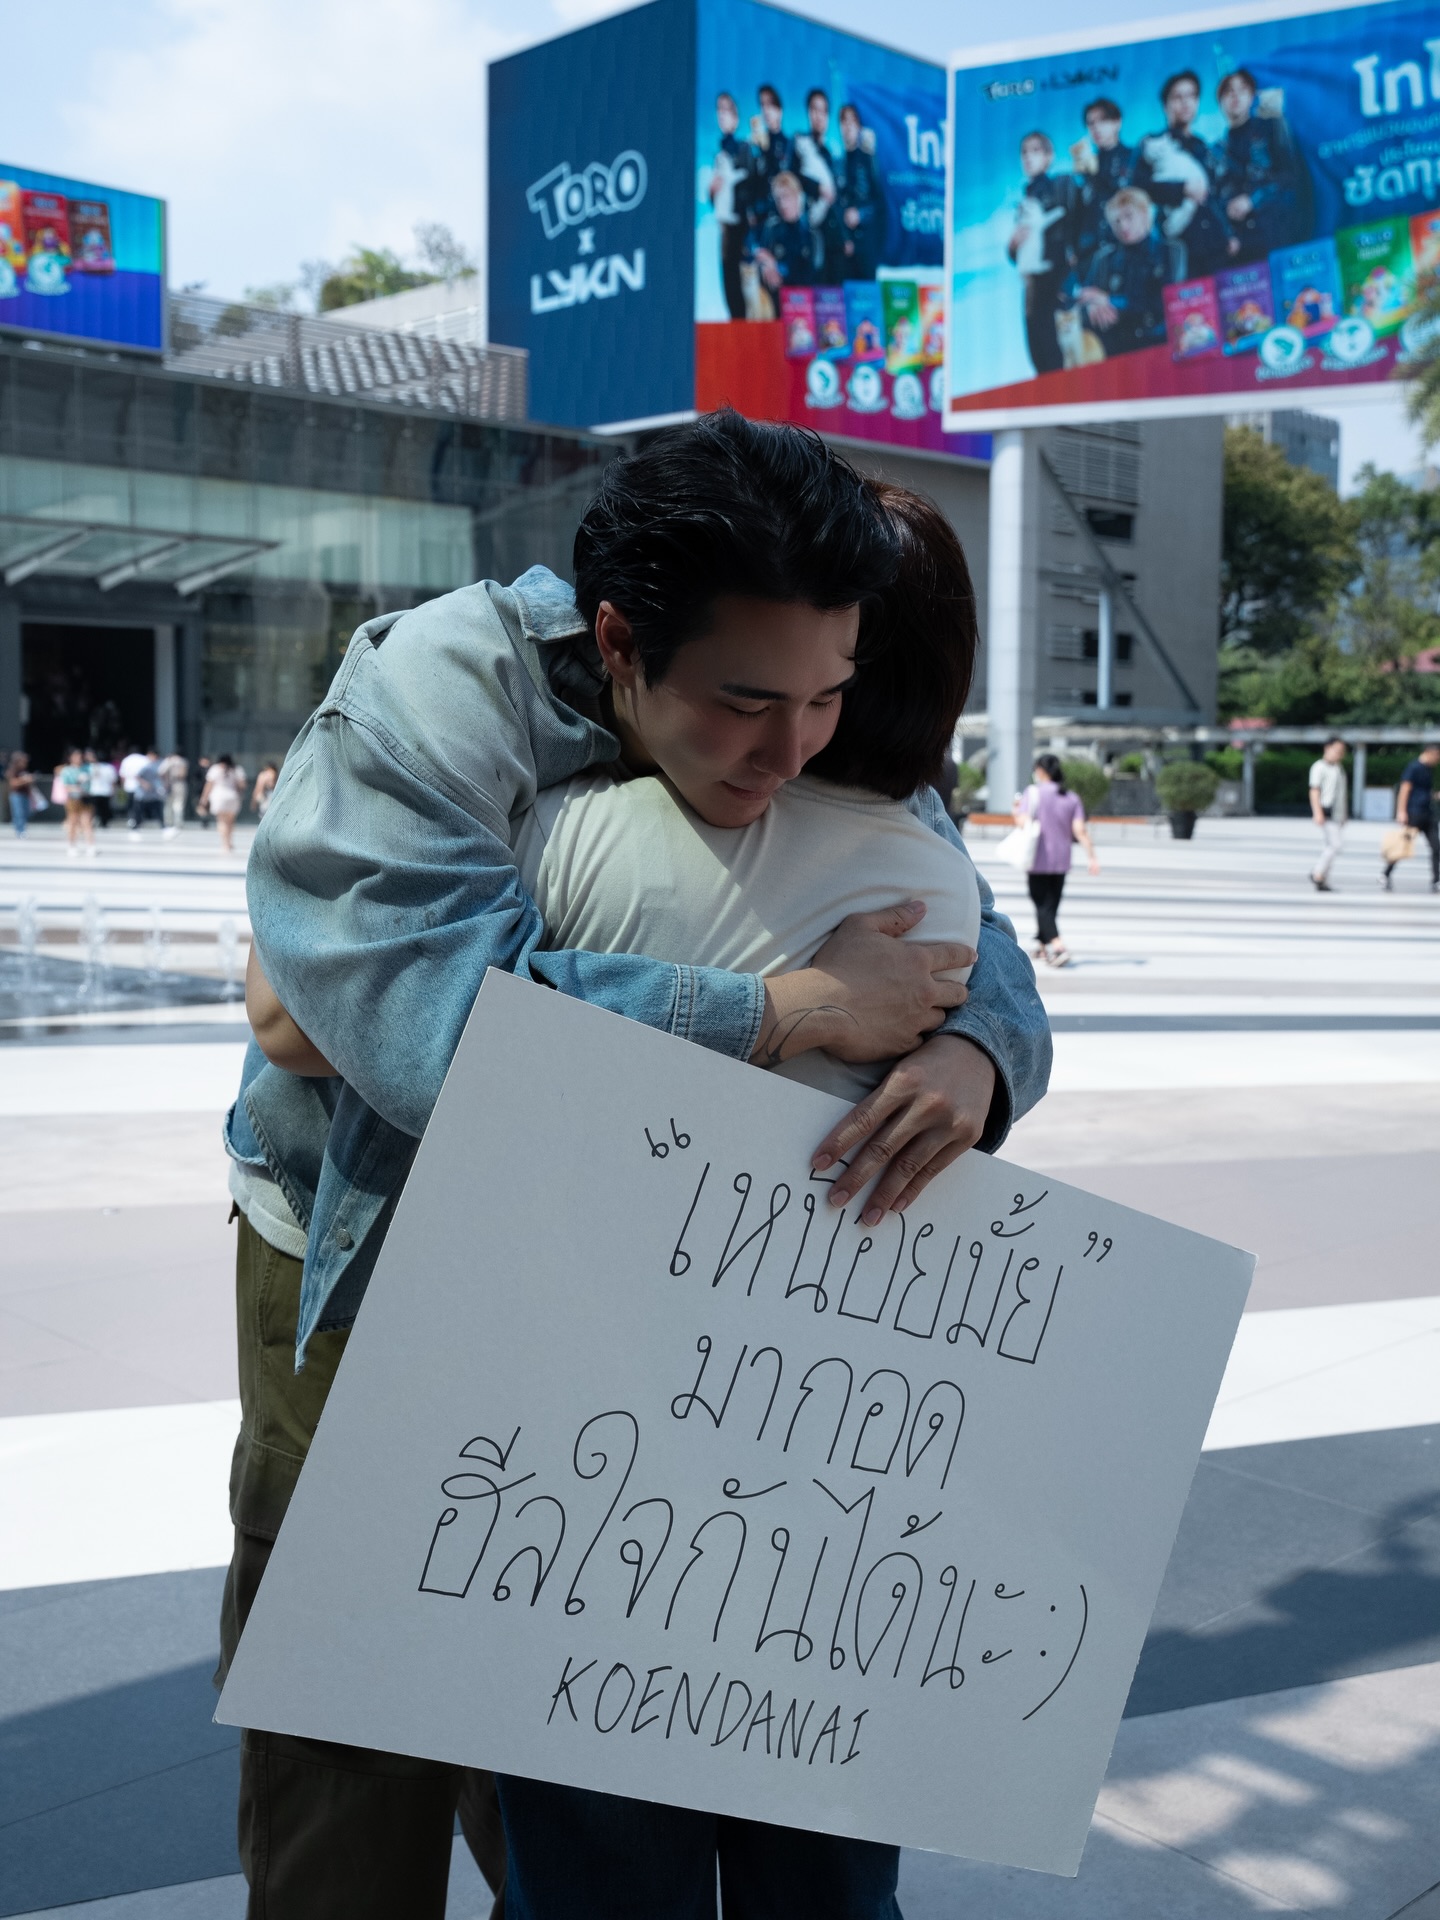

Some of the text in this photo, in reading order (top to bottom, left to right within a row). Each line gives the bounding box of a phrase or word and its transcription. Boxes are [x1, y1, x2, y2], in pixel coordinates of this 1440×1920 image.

[525, 149, 648, 240] TORO
[530, 248, 646, 315] LYKN
[671, 1336, 965, 1489] มากอด
[547, 1657, 870, 1765] KOENDANAI
